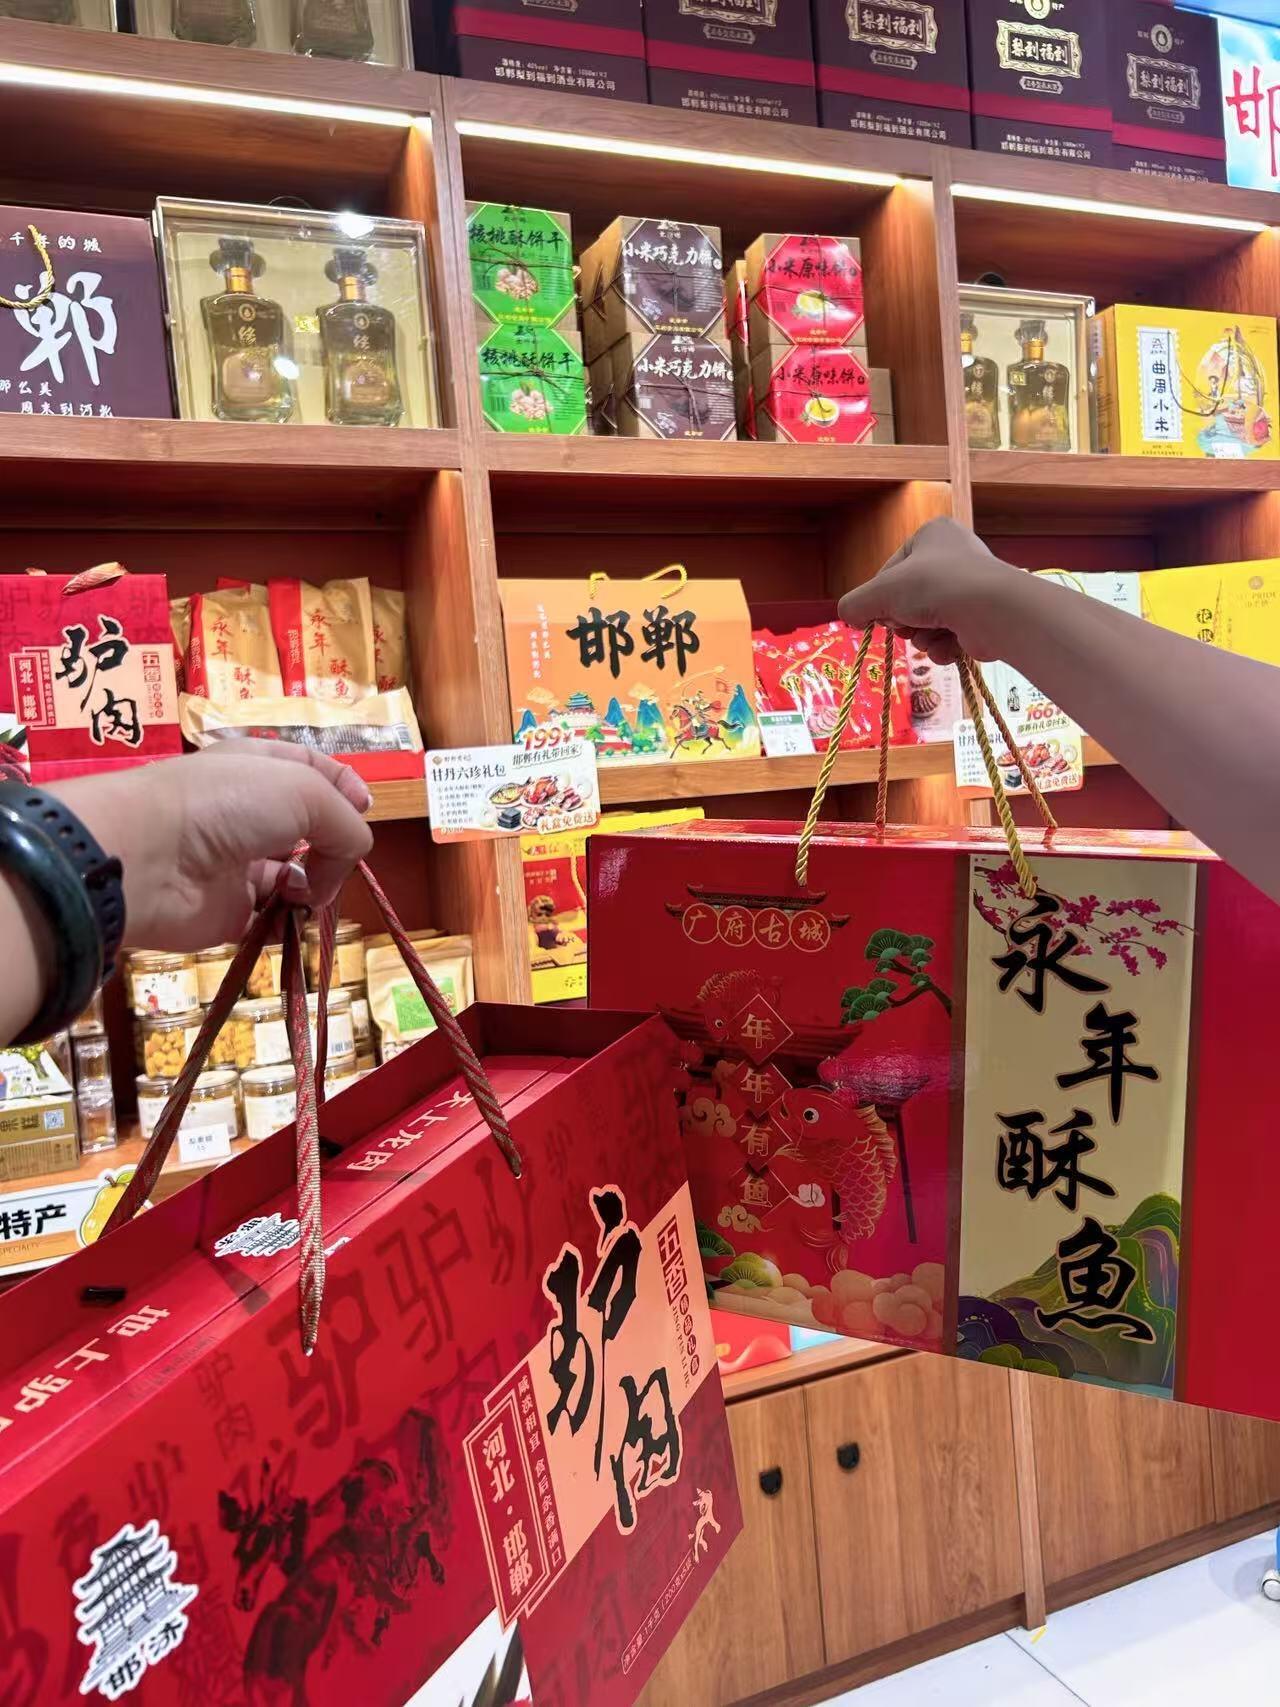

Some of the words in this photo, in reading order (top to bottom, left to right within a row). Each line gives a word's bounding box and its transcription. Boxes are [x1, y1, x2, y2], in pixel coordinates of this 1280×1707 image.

[862, 9, 923, 39] 梨到福到
[1012, 37, 1068, 65] 梨到福到
[1140, 70, 1189, 97] 梨到福到
[469, 223, 563, 253] 核桃酥饼干
[622, 239, 713, 267] 小米巧克力饼
[768, 257, 846, 279] 小米原味饼
[481, 347, 574, 373] 核桃酥饼干
[637, 356, 727, 381] 小米巧克力饼
[776, 366, 855, 388] 小米原味饼
[210, 616, 235, 662] 永年
[309, 608, 331, 656] 永年
[566, 605, 700, 679] 邯郸
[55, 614, 143, 745] 驴肉
[512, 744, 582, 766] 邯郸有礼带回家
[432, 764, 507, 781] 甘丹六珍礼包
[540, 814, 595, 831] 礼盒免费送
[687, 909, 826, 943] 广府古城
[740, 1013, 776, 1208] 年年有鱼
[0, 1204, 66, 1240] 特产
[657, 1213, 688, 1306] 五香
[547, 1190, 680, 1531] 驴肉
[518, 1374, 541, 1453] 咸淡相宜
